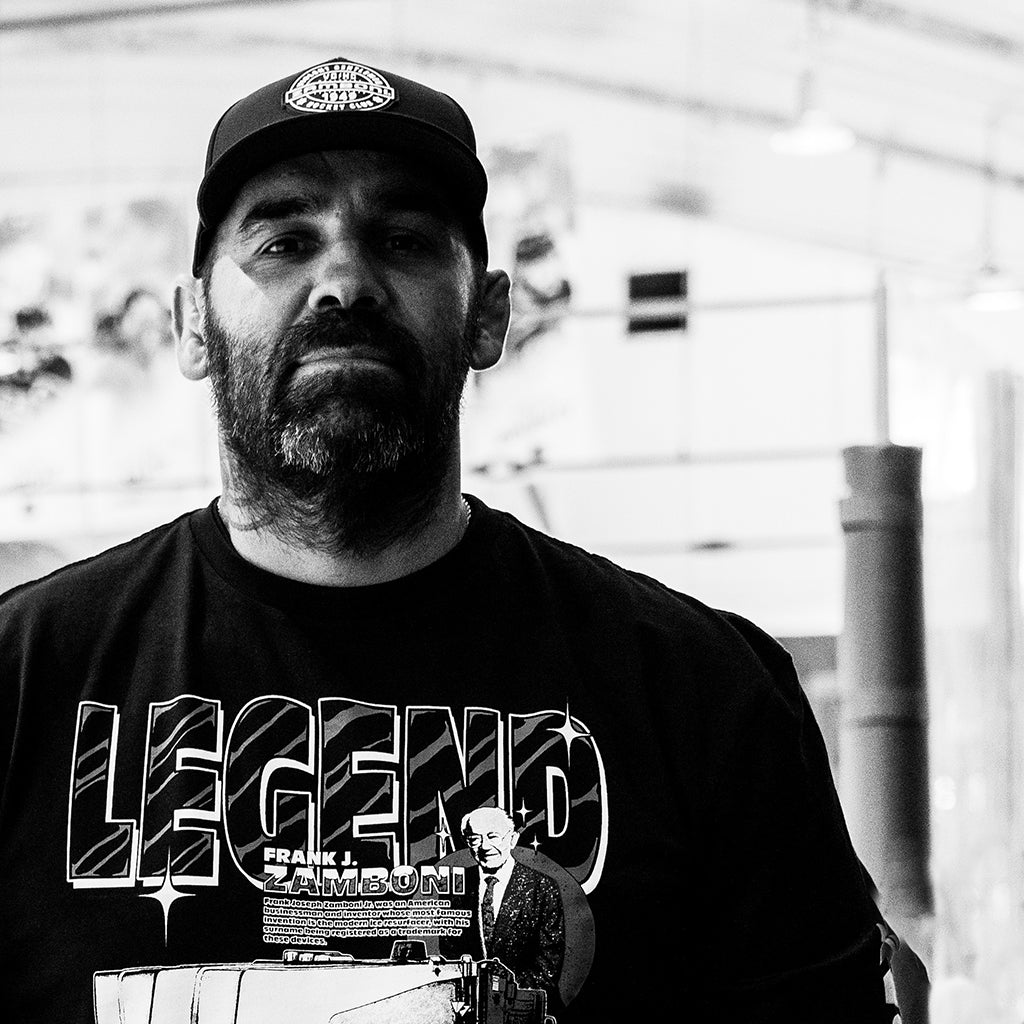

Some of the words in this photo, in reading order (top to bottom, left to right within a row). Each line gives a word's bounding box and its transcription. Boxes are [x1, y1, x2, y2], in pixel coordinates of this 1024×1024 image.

[66, 694, 609, 894] LEGEND
[264, 847, 336, 866] FRANK
[341, 851, 358, 866] J.
[263, 864, 465, 897] ZAMBONI
[263, 897, 291, 906] Frank
[291, 899, 323, 908] Joseph
[407, 900, 451, 908] American
[263, 906, 323, 917] businessman
[324, 910, 342, 918] and
[343, 910, 381, 918] inventor
[382, 909, 411, 918] whose
[435, 909, 472, 917] famous
[263, 916, 307, 925] invention
[317, 919, 333, 927] the
[454, 919, 470, 927] his
[263, 926, 303, 935] surname
[304, 928, 330, 937] being
[331, 928, 377, 937] registered
[398, 928, 447, 936] trademark
[263, 934, 290, 943] these
[290, 936, 327, 945] devices.
